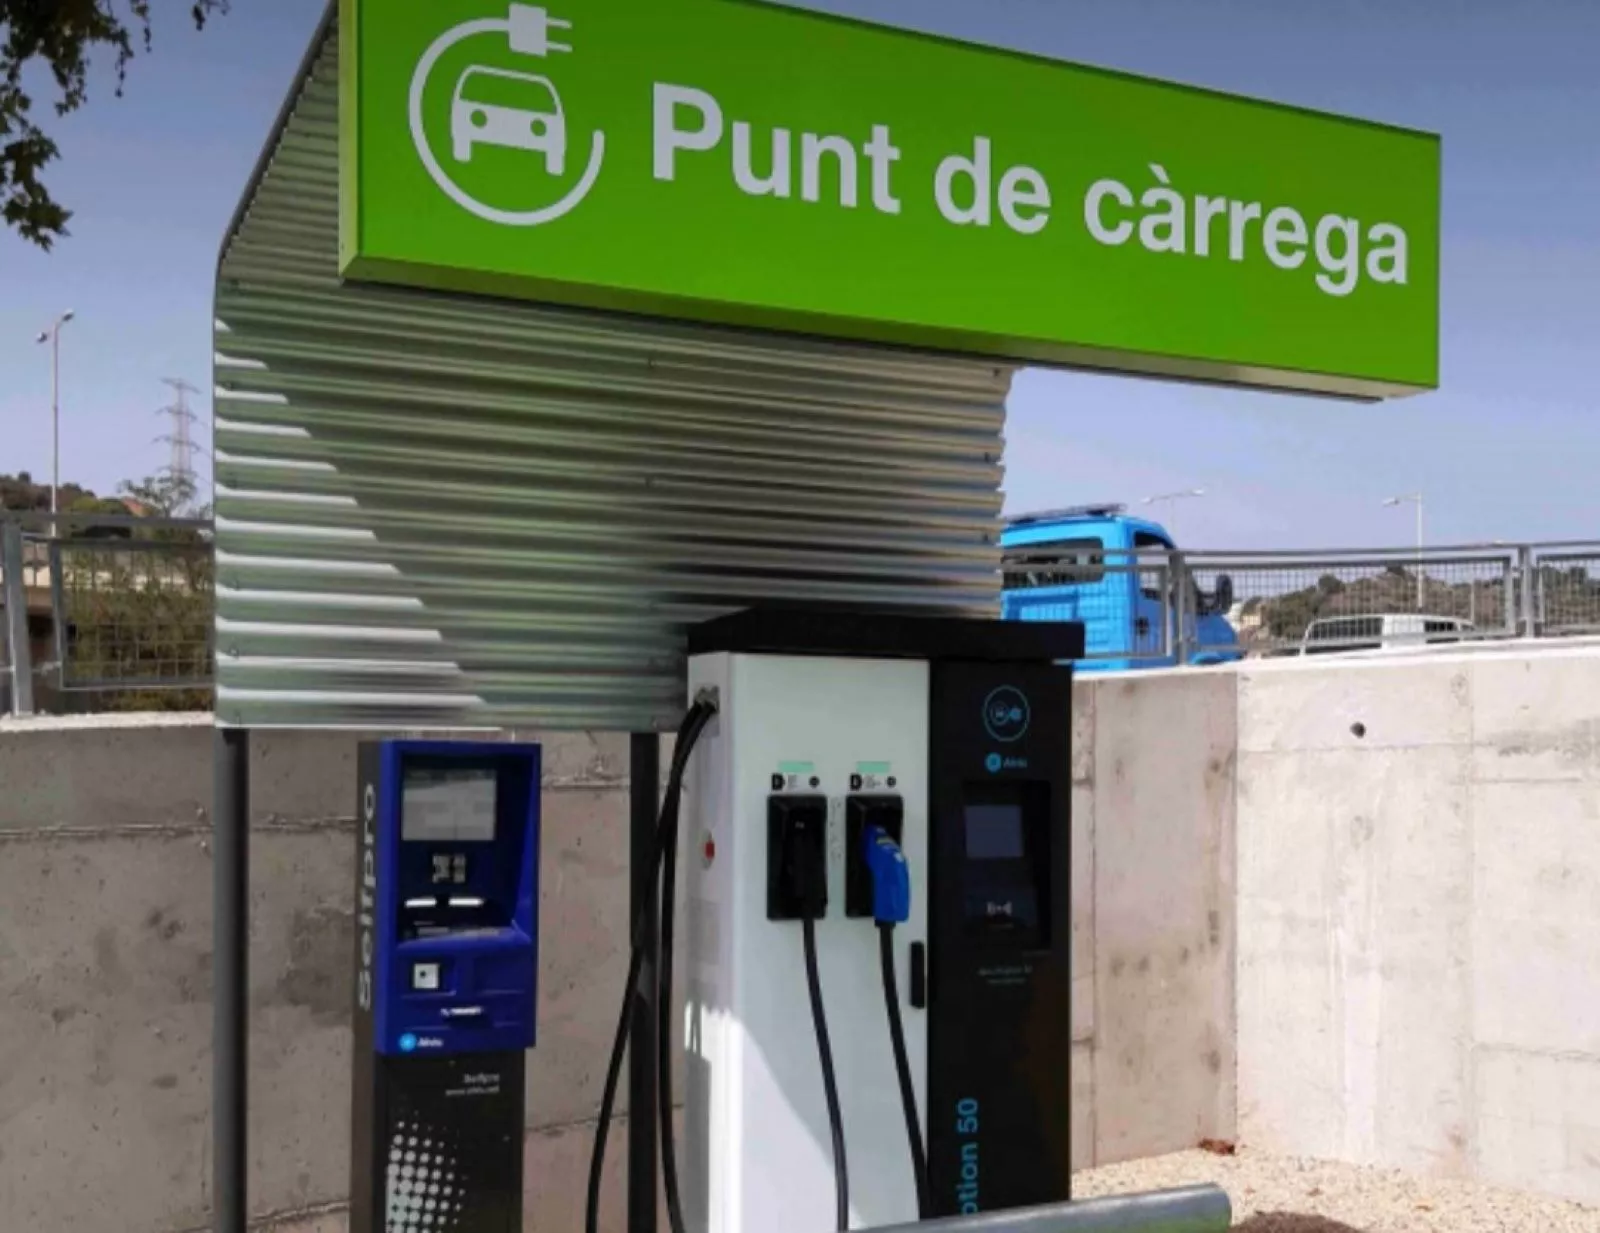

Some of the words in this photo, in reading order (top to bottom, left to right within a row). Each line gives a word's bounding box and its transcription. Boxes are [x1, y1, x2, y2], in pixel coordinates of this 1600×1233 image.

[653, 81, 901, 215] Punt
[934, 136, 1051, 234] de
[1084, 163, 1408, 297] càrrega
[957, 1098, 978, 1133] 50
